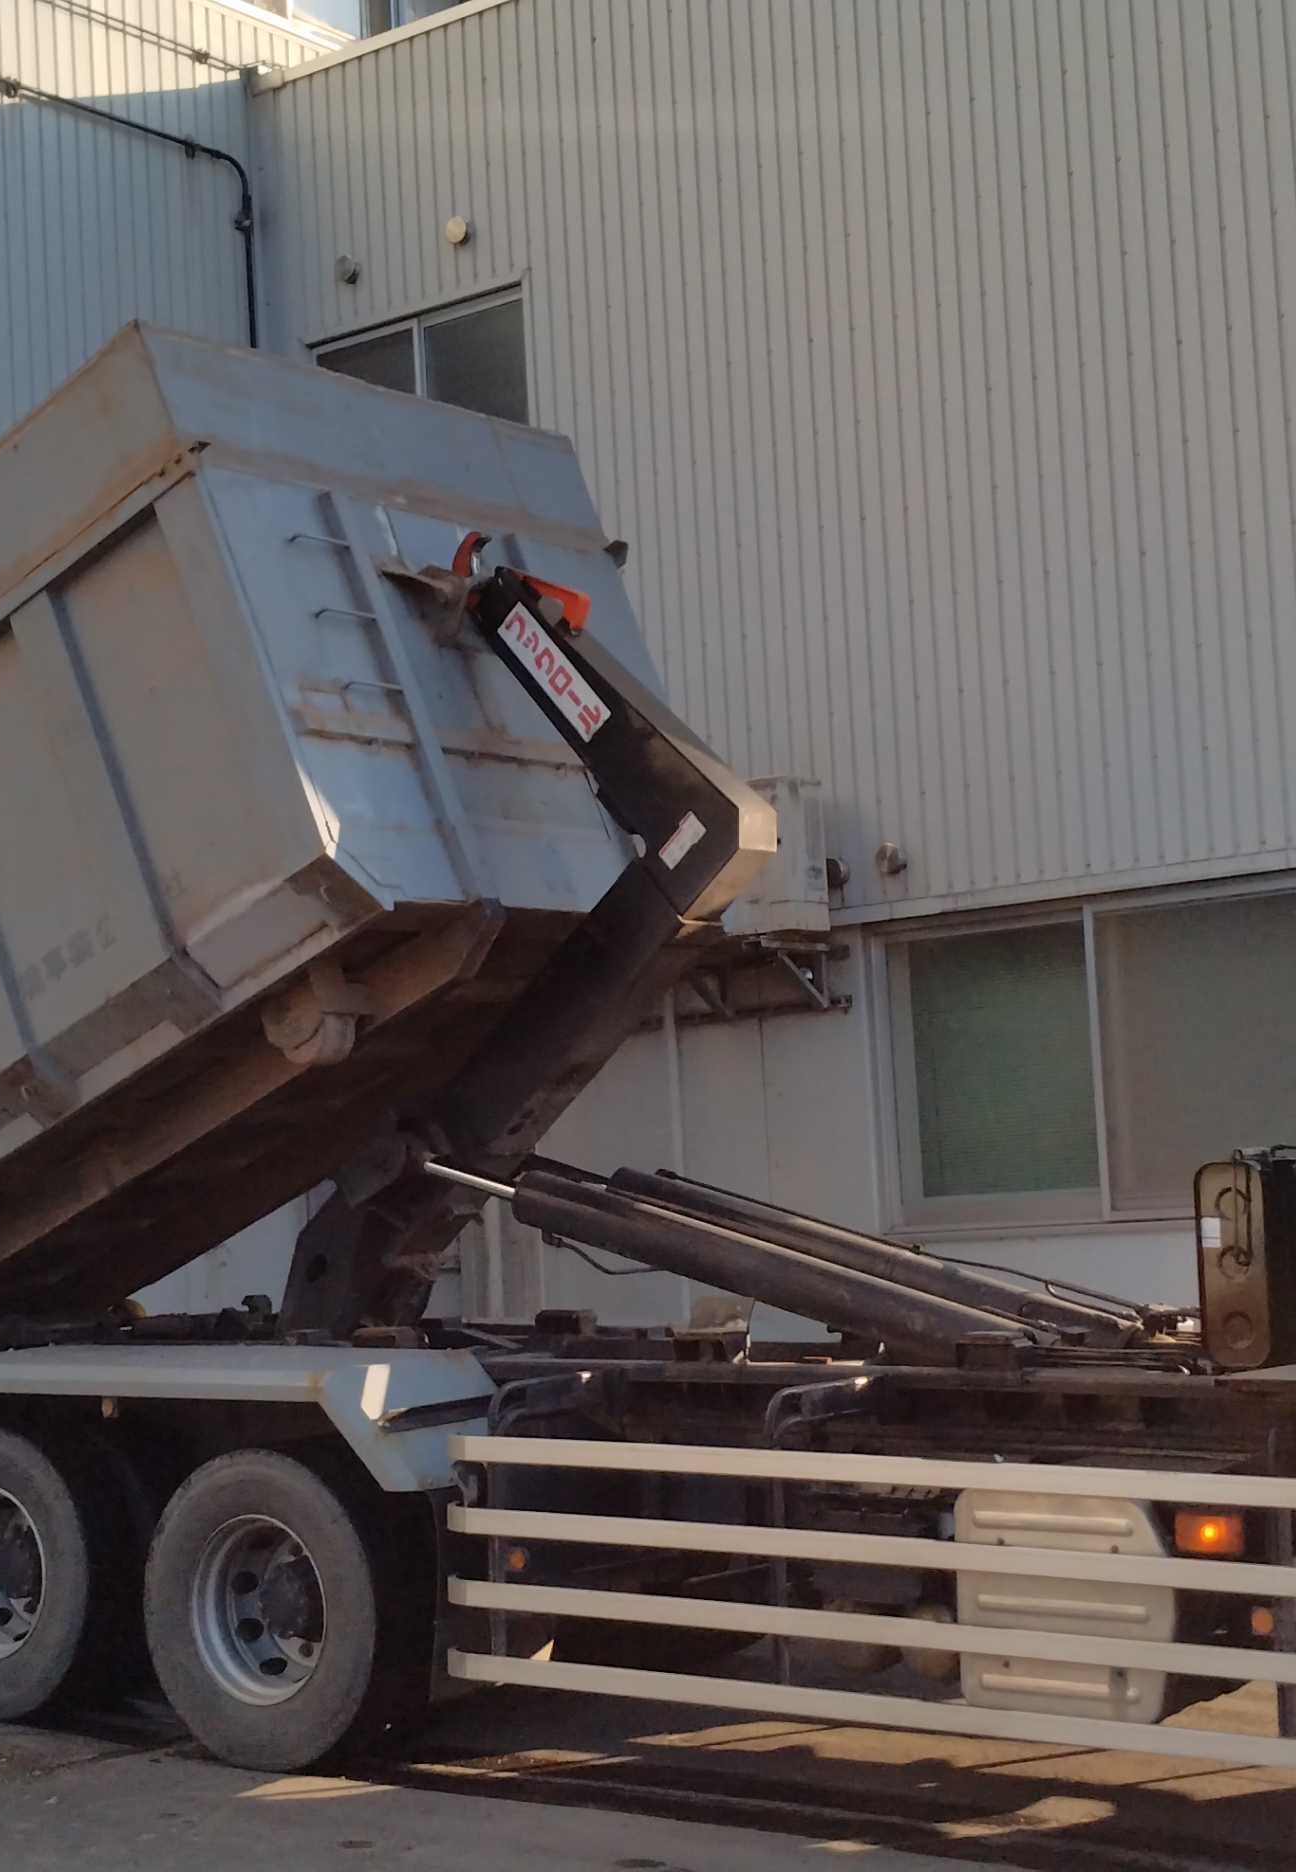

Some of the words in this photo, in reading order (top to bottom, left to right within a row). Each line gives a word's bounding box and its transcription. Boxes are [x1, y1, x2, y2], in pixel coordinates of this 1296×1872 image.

[505, 611, 601, 734] フックロール
